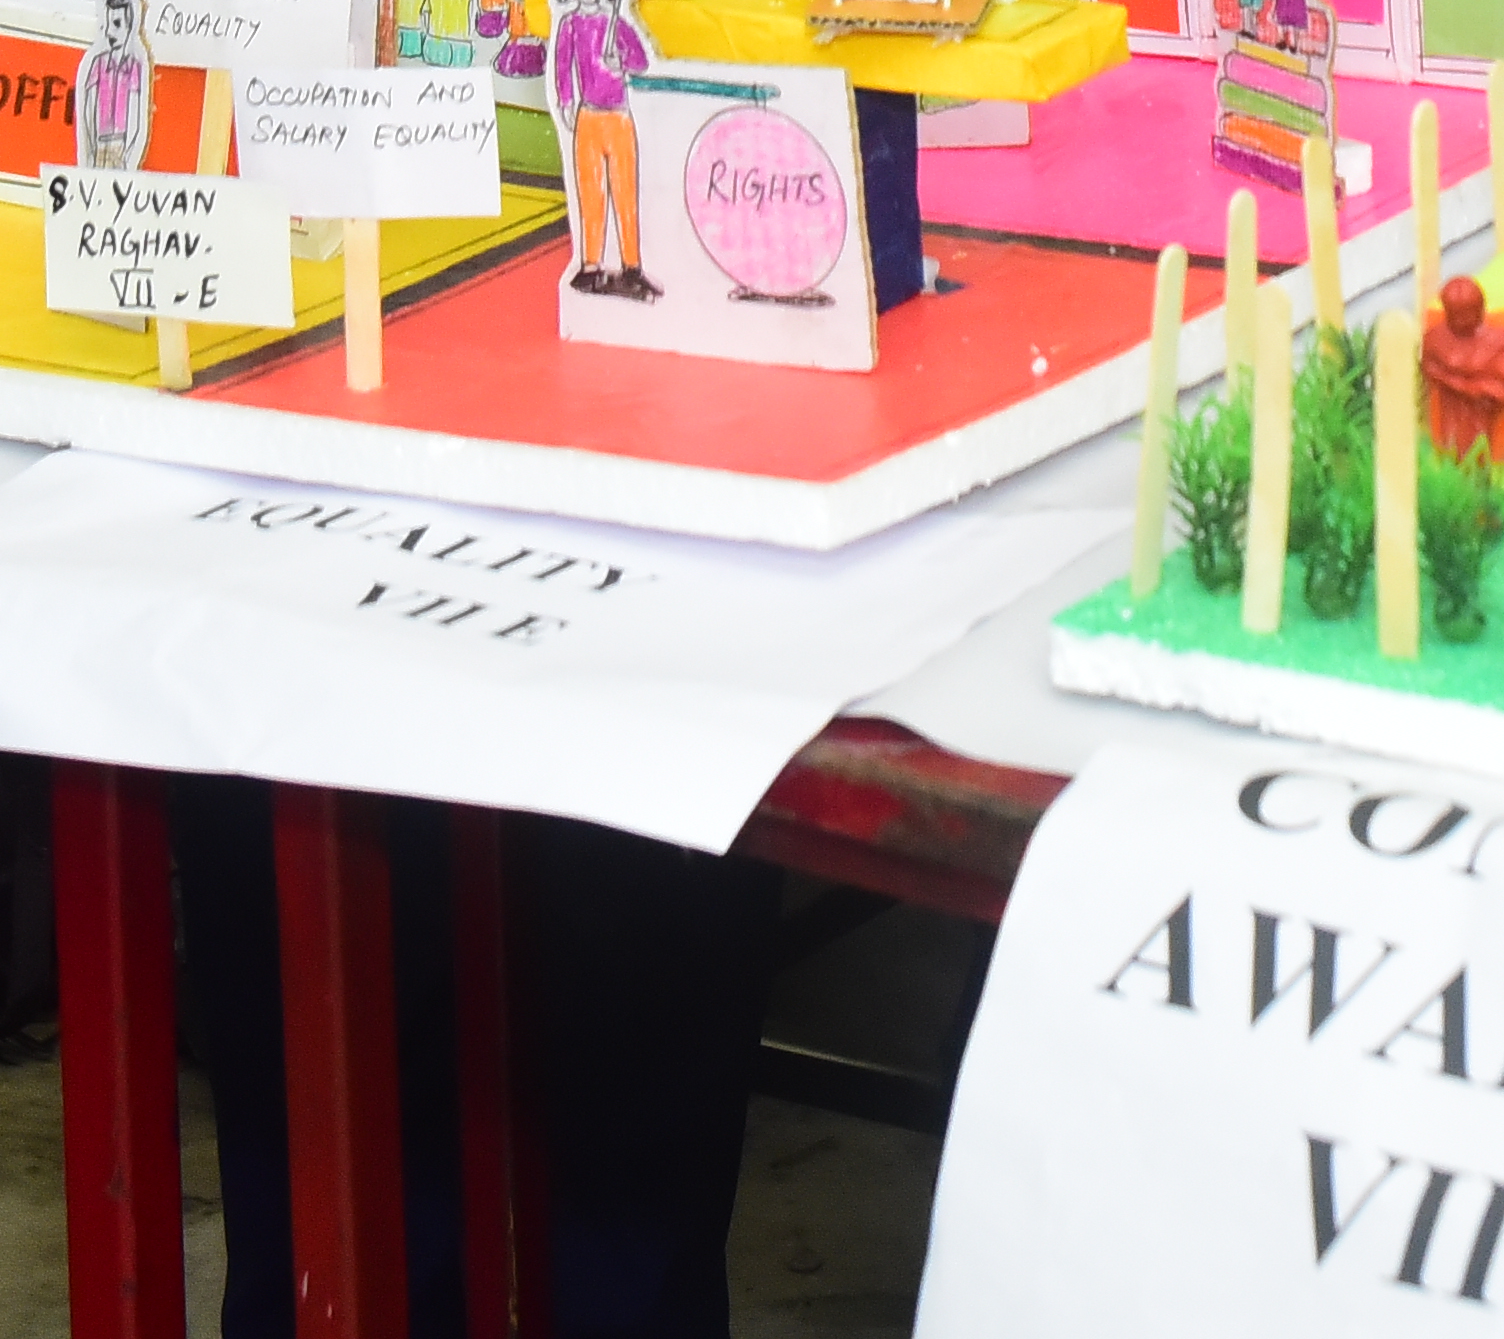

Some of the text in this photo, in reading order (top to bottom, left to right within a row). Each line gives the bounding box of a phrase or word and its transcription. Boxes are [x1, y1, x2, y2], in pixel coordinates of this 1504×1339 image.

[155, 3, 262, 49] EQUALITY
[245, 77, 475, 108] OCCUPATION AND
[251, 115, 496, 155] SALARY EQUALITY
[112, 180, 216, 225] YUVAN
[705, 158, 828, 219] RIGHTS
[78, 223, 213, 269] RAGHAV.
[110, 268, 156, 309] VII
[199, 274, 220, 309] E
[193, 493, 659, 596] EQUALITY
[356, 581, 571, 649] VII E
